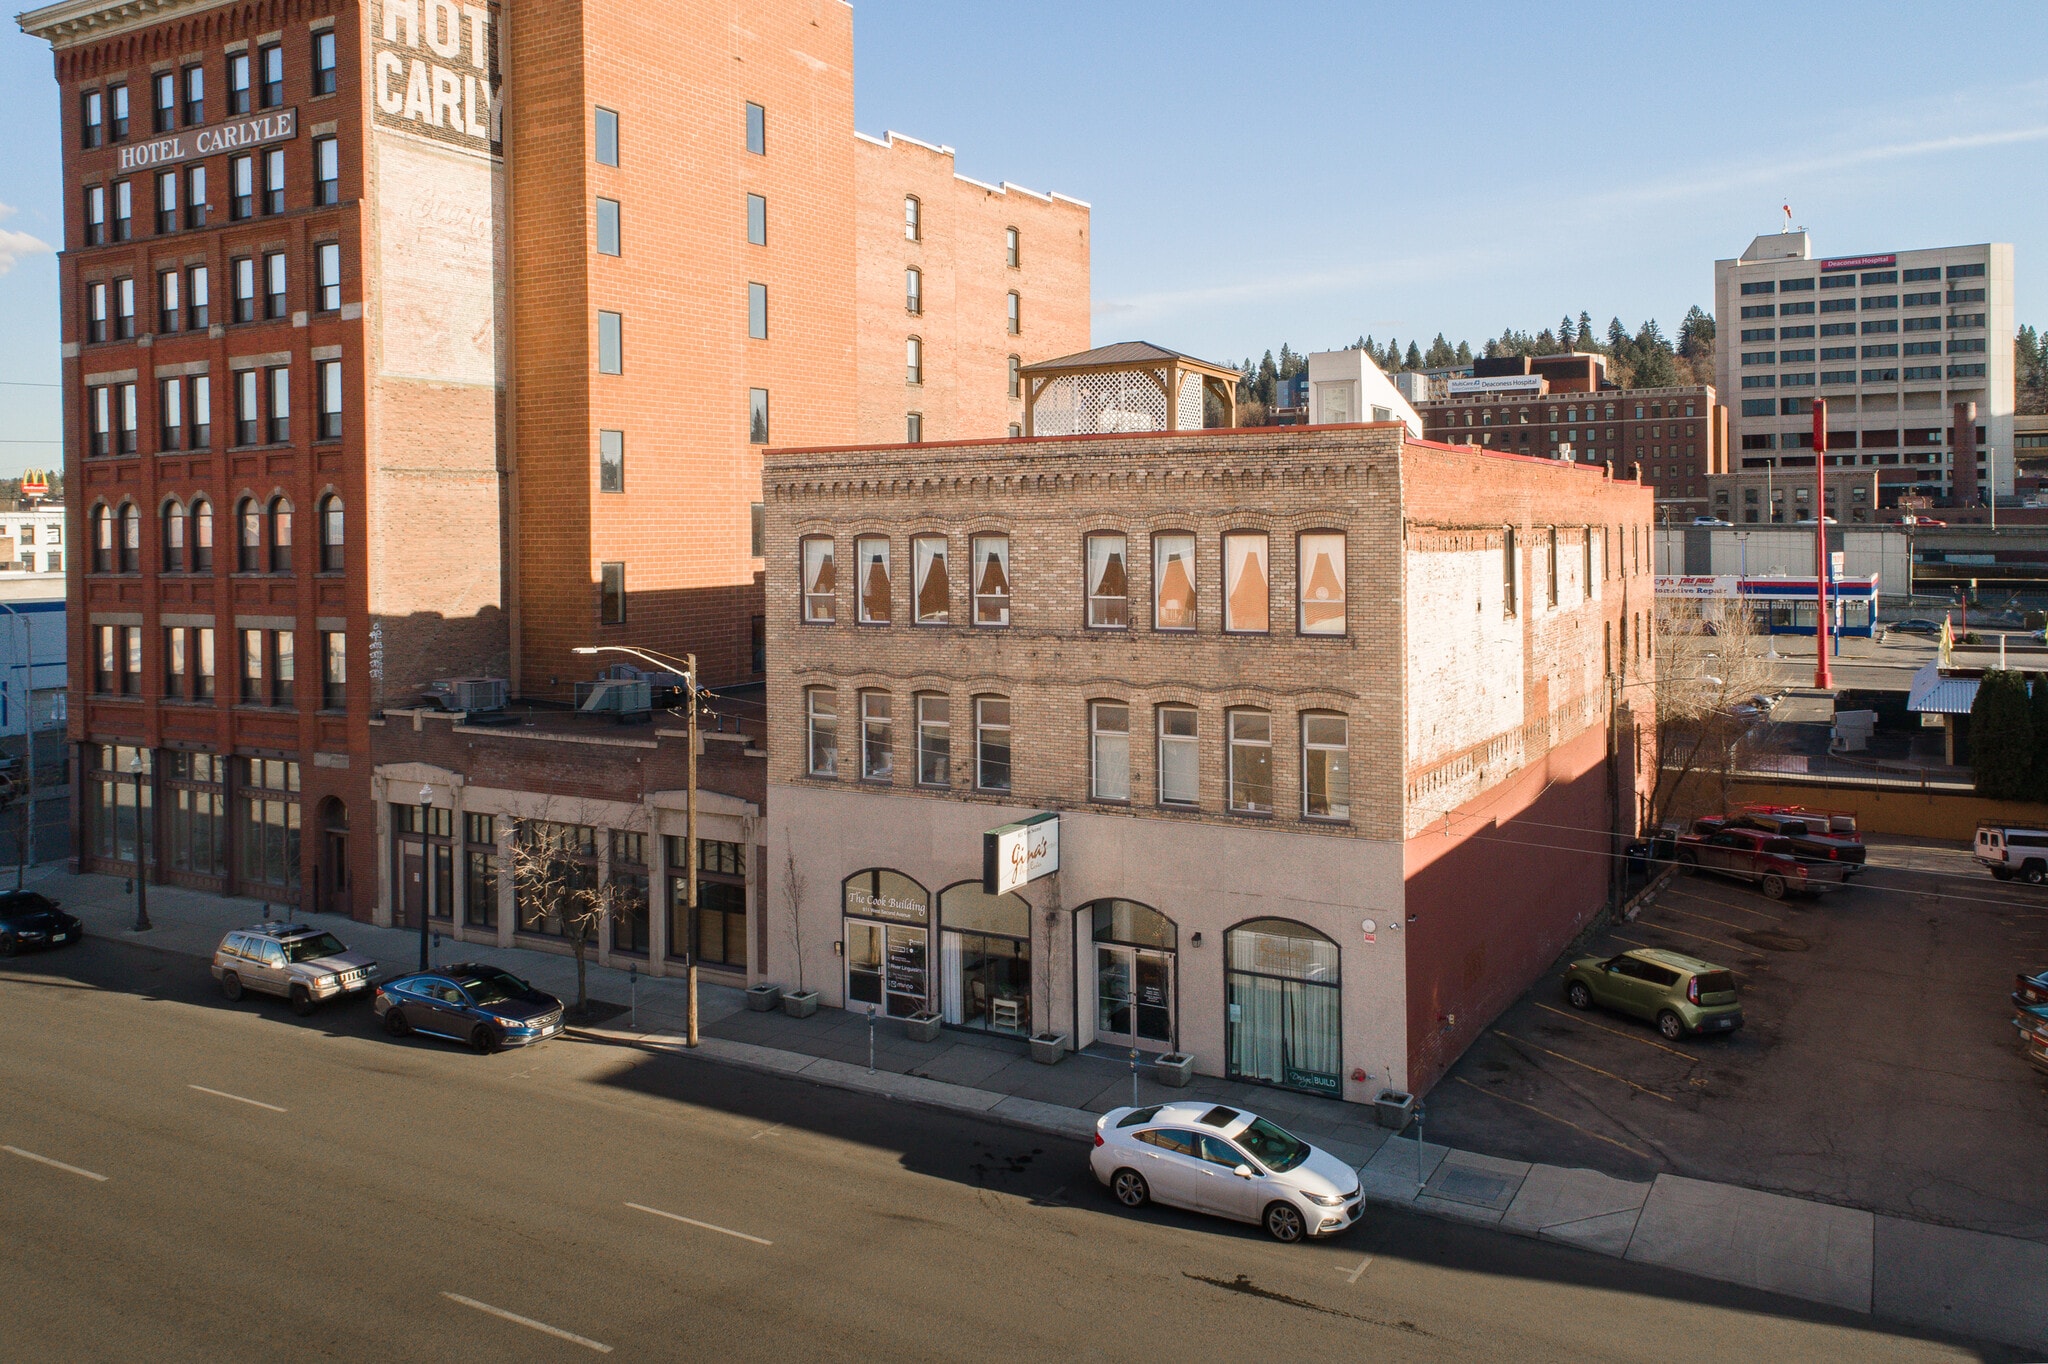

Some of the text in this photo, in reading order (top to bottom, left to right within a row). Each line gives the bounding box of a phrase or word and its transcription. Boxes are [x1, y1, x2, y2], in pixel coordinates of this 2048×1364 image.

[121, 113, 291, 169] HOTEL CARLYLE
[1828, 256, 1889, 268] Deaconess Hospital
[1482, 378, 1538, 388] Deaconess Hospital
[1677, 577, 1695, 587] TIRE
[1693, 577, 1716, 587] PROS
[1696, 587, 1727, 595] Repair
[1011, 836, 1048, 884] Gina's
[848, 892, 927, 917] The Cook Building
[1314, 1076, 1336, 1087] BUILD
